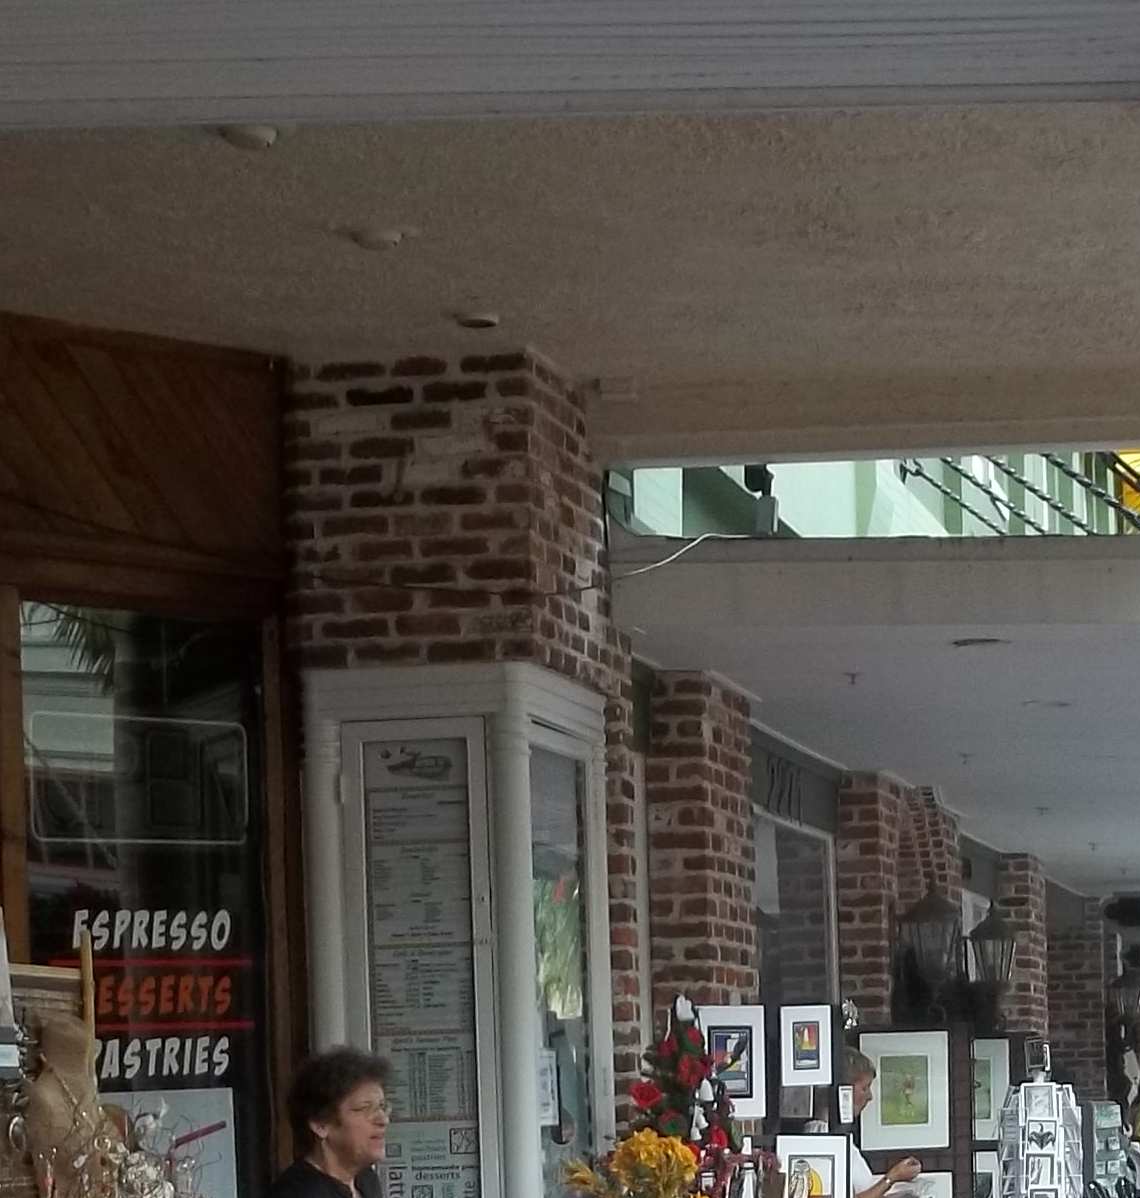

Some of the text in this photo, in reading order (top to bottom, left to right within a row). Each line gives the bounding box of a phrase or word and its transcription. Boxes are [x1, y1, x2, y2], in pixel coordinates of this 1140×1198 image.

[72, 908, 231, 950] ESPRESSO
[98, 975, 232, 1016] ESSERTS
[415, 1170, 461, 1182] desserts
